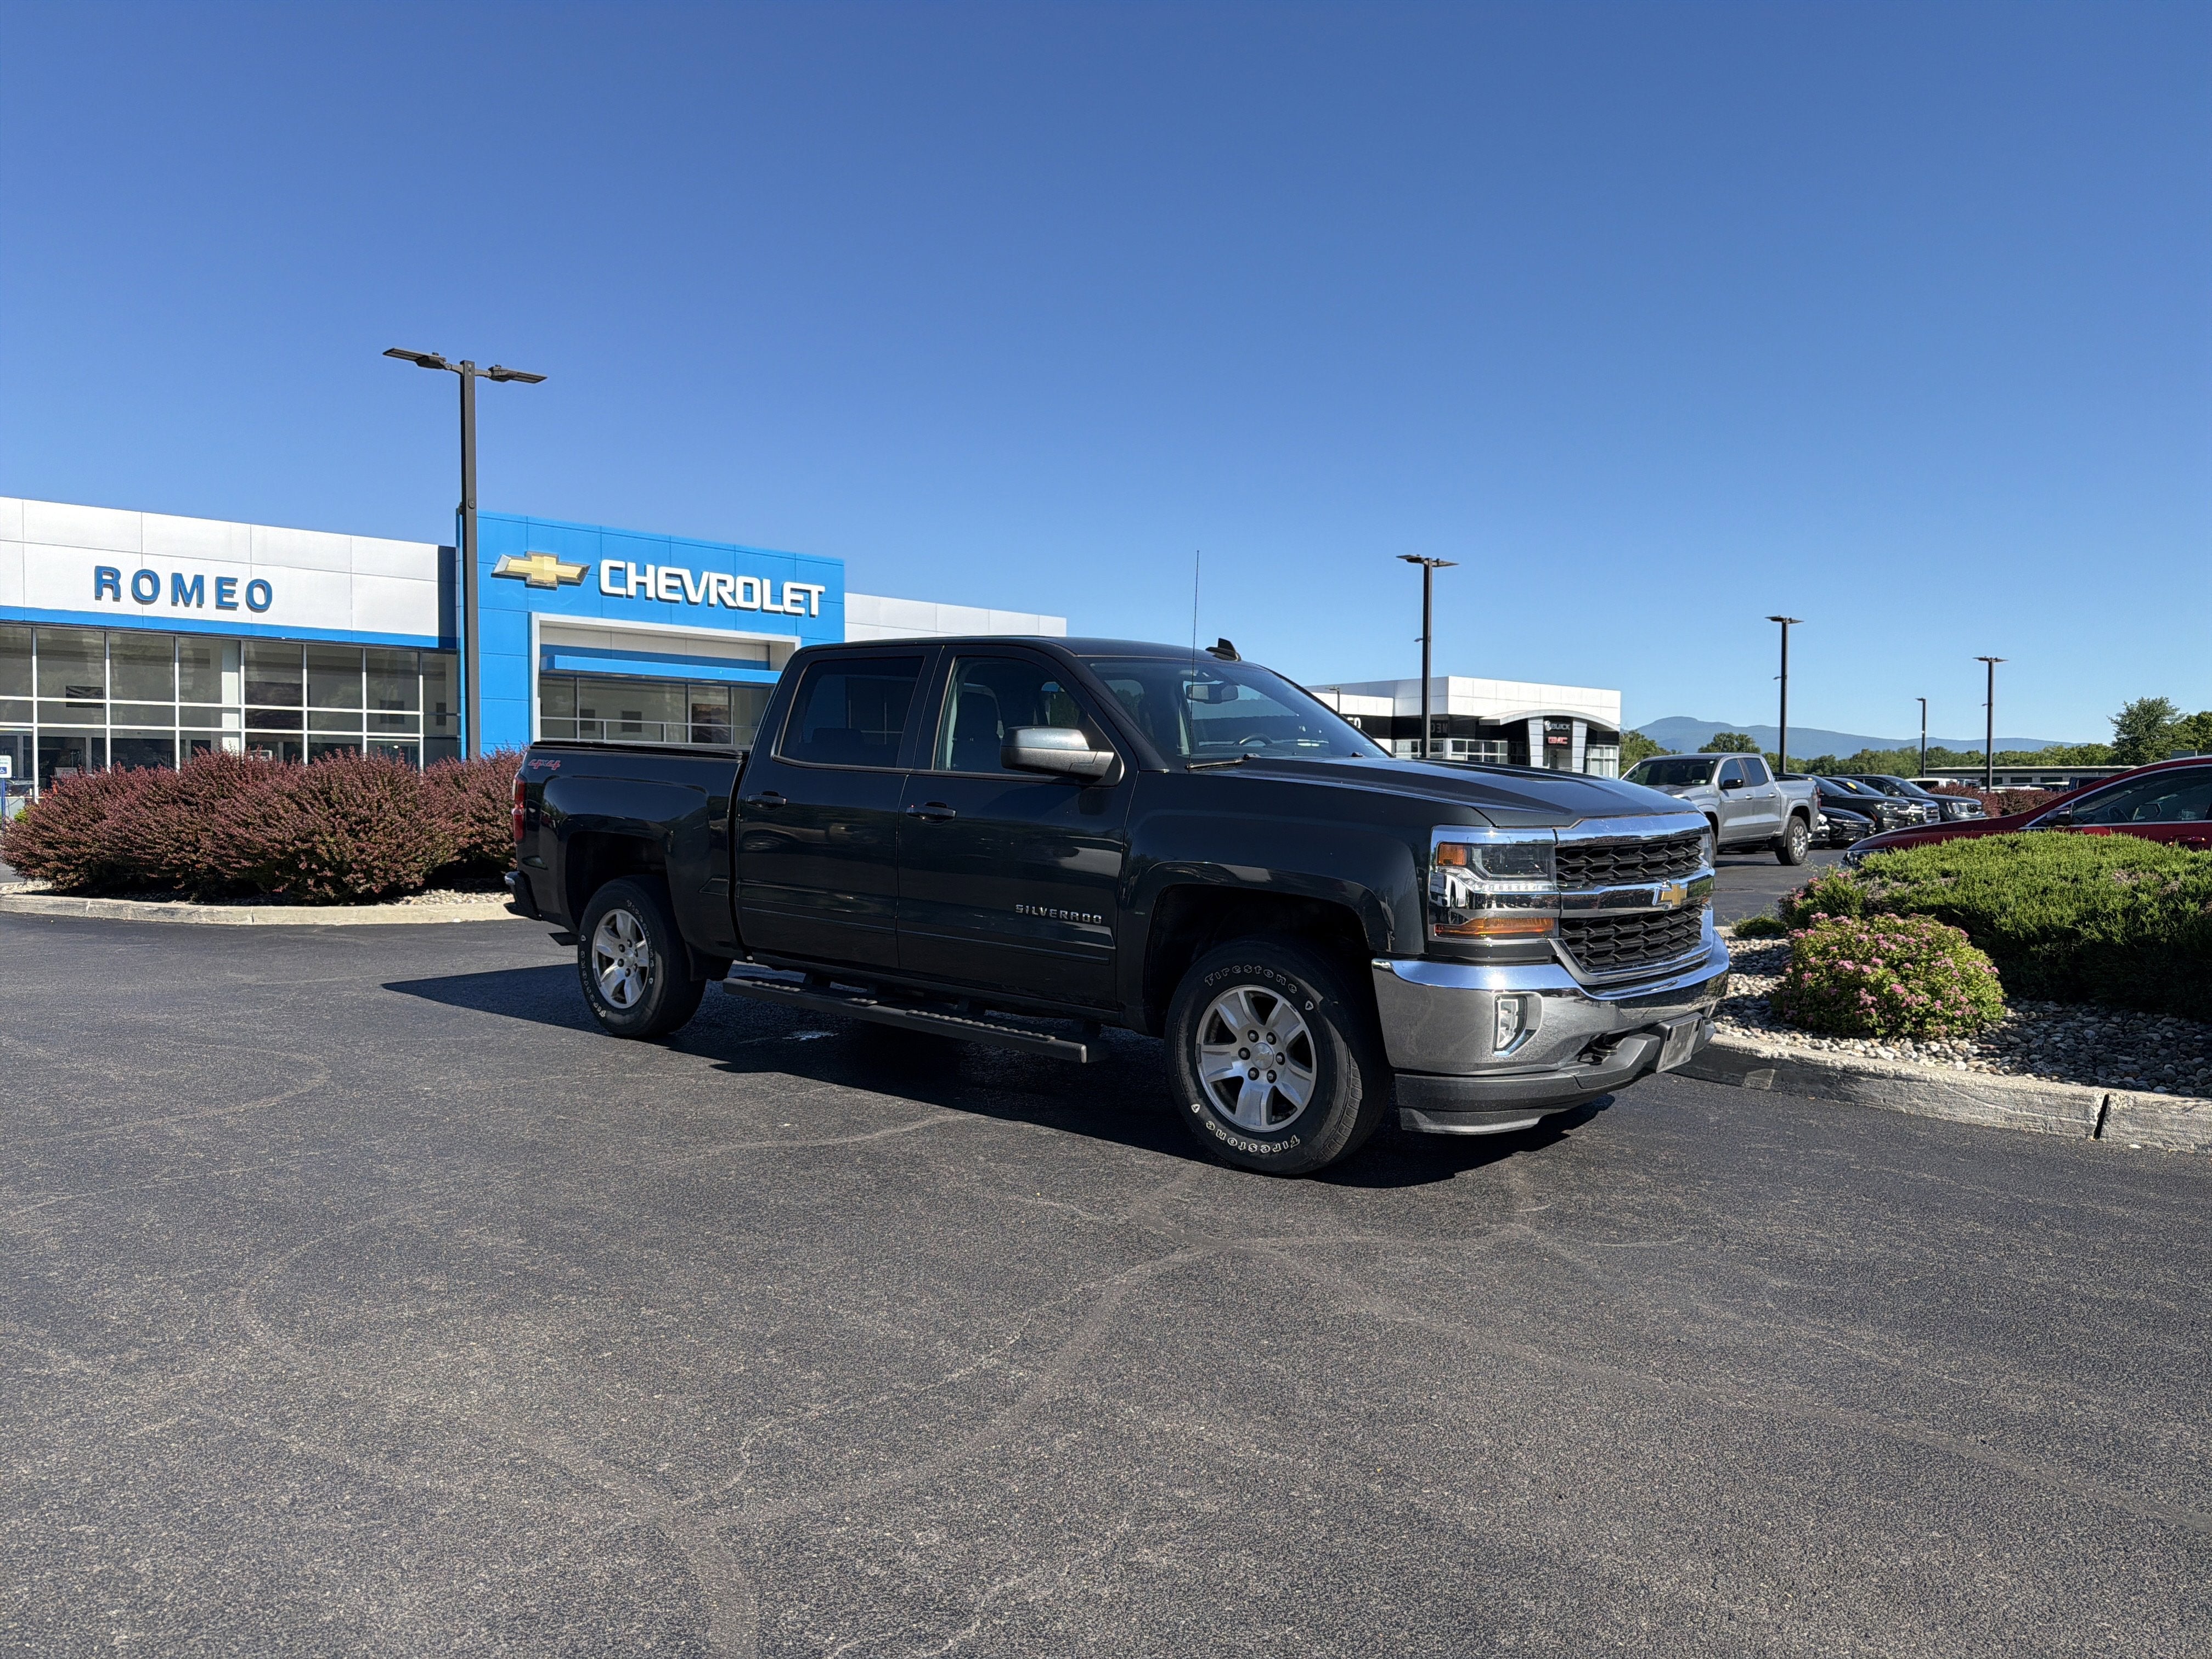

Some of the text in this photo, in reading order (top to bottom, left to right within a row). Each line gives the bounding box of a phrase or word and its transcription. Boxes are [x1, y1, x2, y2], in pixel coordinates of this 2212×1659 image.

[94, 566, 272, 613] ROMEO
[600, 558, 825, 618] CHEVROLET
[1548, 736, 1568, 744] GMC
[1015, 904, 1102, 924] SILVERADO
[1204, 964, 1297, 994] Firestone
[1206, 1120, 1300, 1153] Firestone
